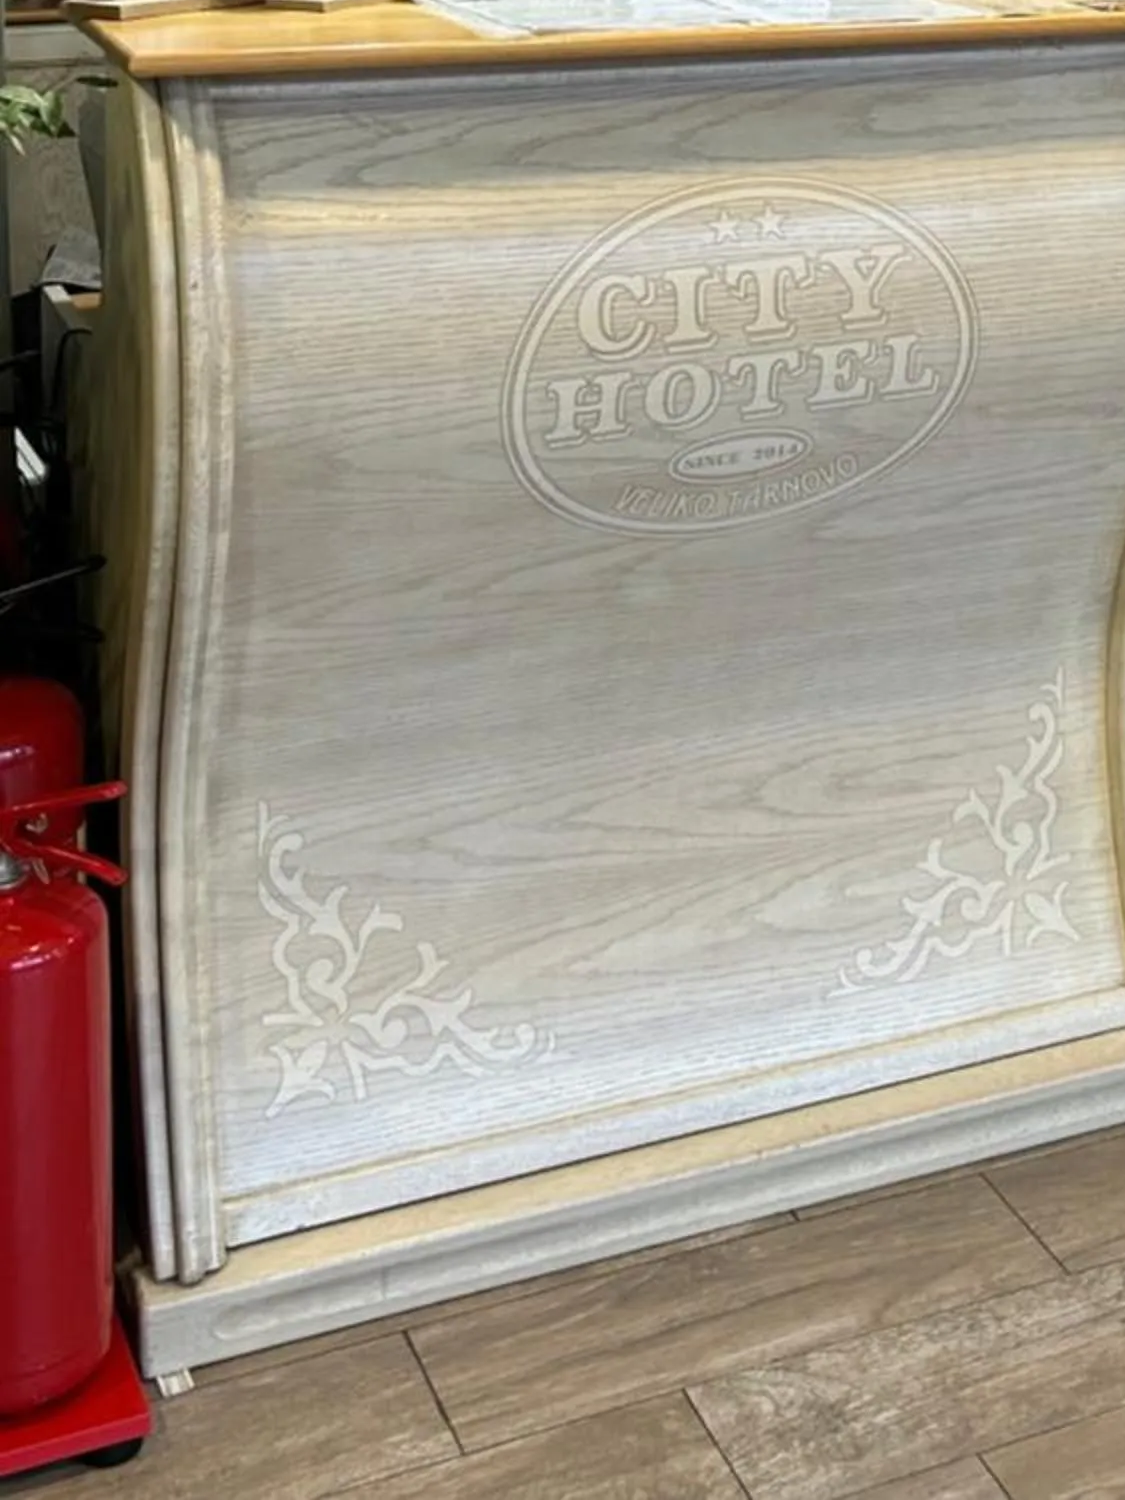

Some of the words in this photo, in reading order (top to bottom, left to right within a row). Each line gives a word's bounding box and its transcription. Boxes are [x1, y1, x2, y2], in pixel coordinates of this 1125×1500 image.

[578, 243, 912, 362] CITY
[545, 334, 941, 449] HOTEL
[613, 483, 719, 519] VELIKO
[727, 451, 859, 516] TARNOVO
[683, 452, 740, 470] SINCE
